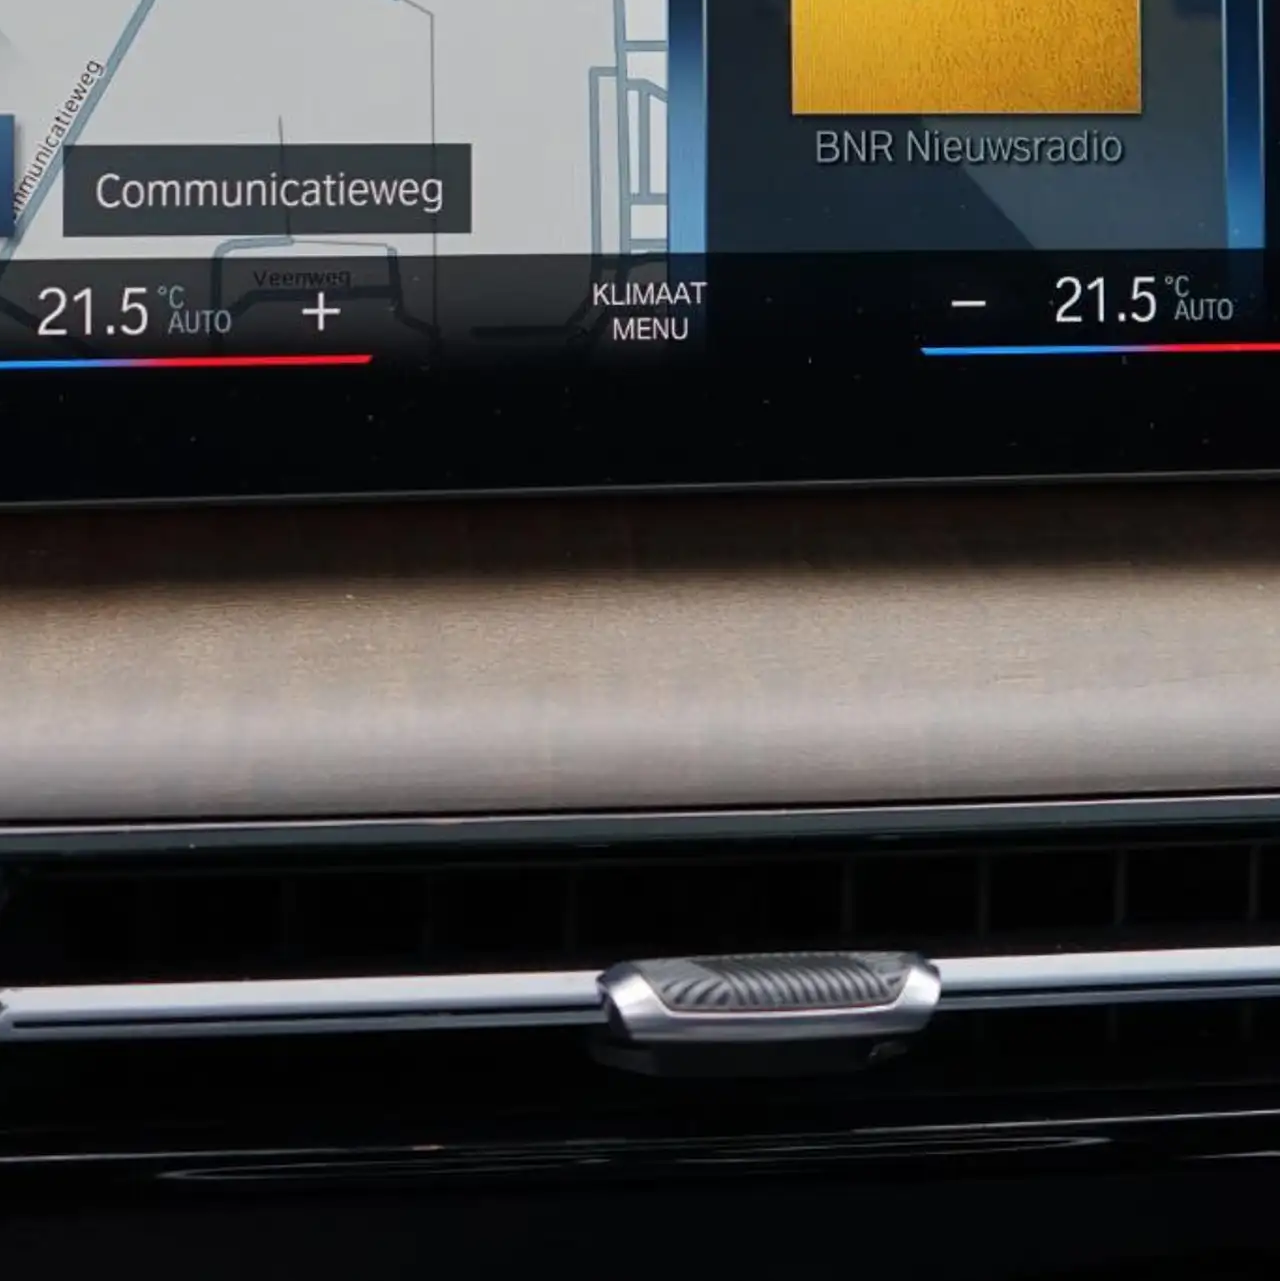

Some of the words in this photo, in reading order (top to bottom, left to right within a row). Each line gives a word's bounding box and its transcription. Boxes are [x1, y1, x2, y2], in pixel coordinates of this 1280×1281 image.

[814, 131, 895, 164] BNR
[906, 131, 1123, 166] Nieuwsradio
[95, 172, 444, 214] Communicatieweg
[253, 270, 352, 287] Veenweg
[592, 281, 708, 306] KLIMAAT
[1054, 275, 1158, 323] 21.5
[36, 286, 149, 336] 21.5
[168, 310, 233, 334] AUTO
[1173, 298, 1235, 321] AUTO
[613, 316, 689, 341] MENU
